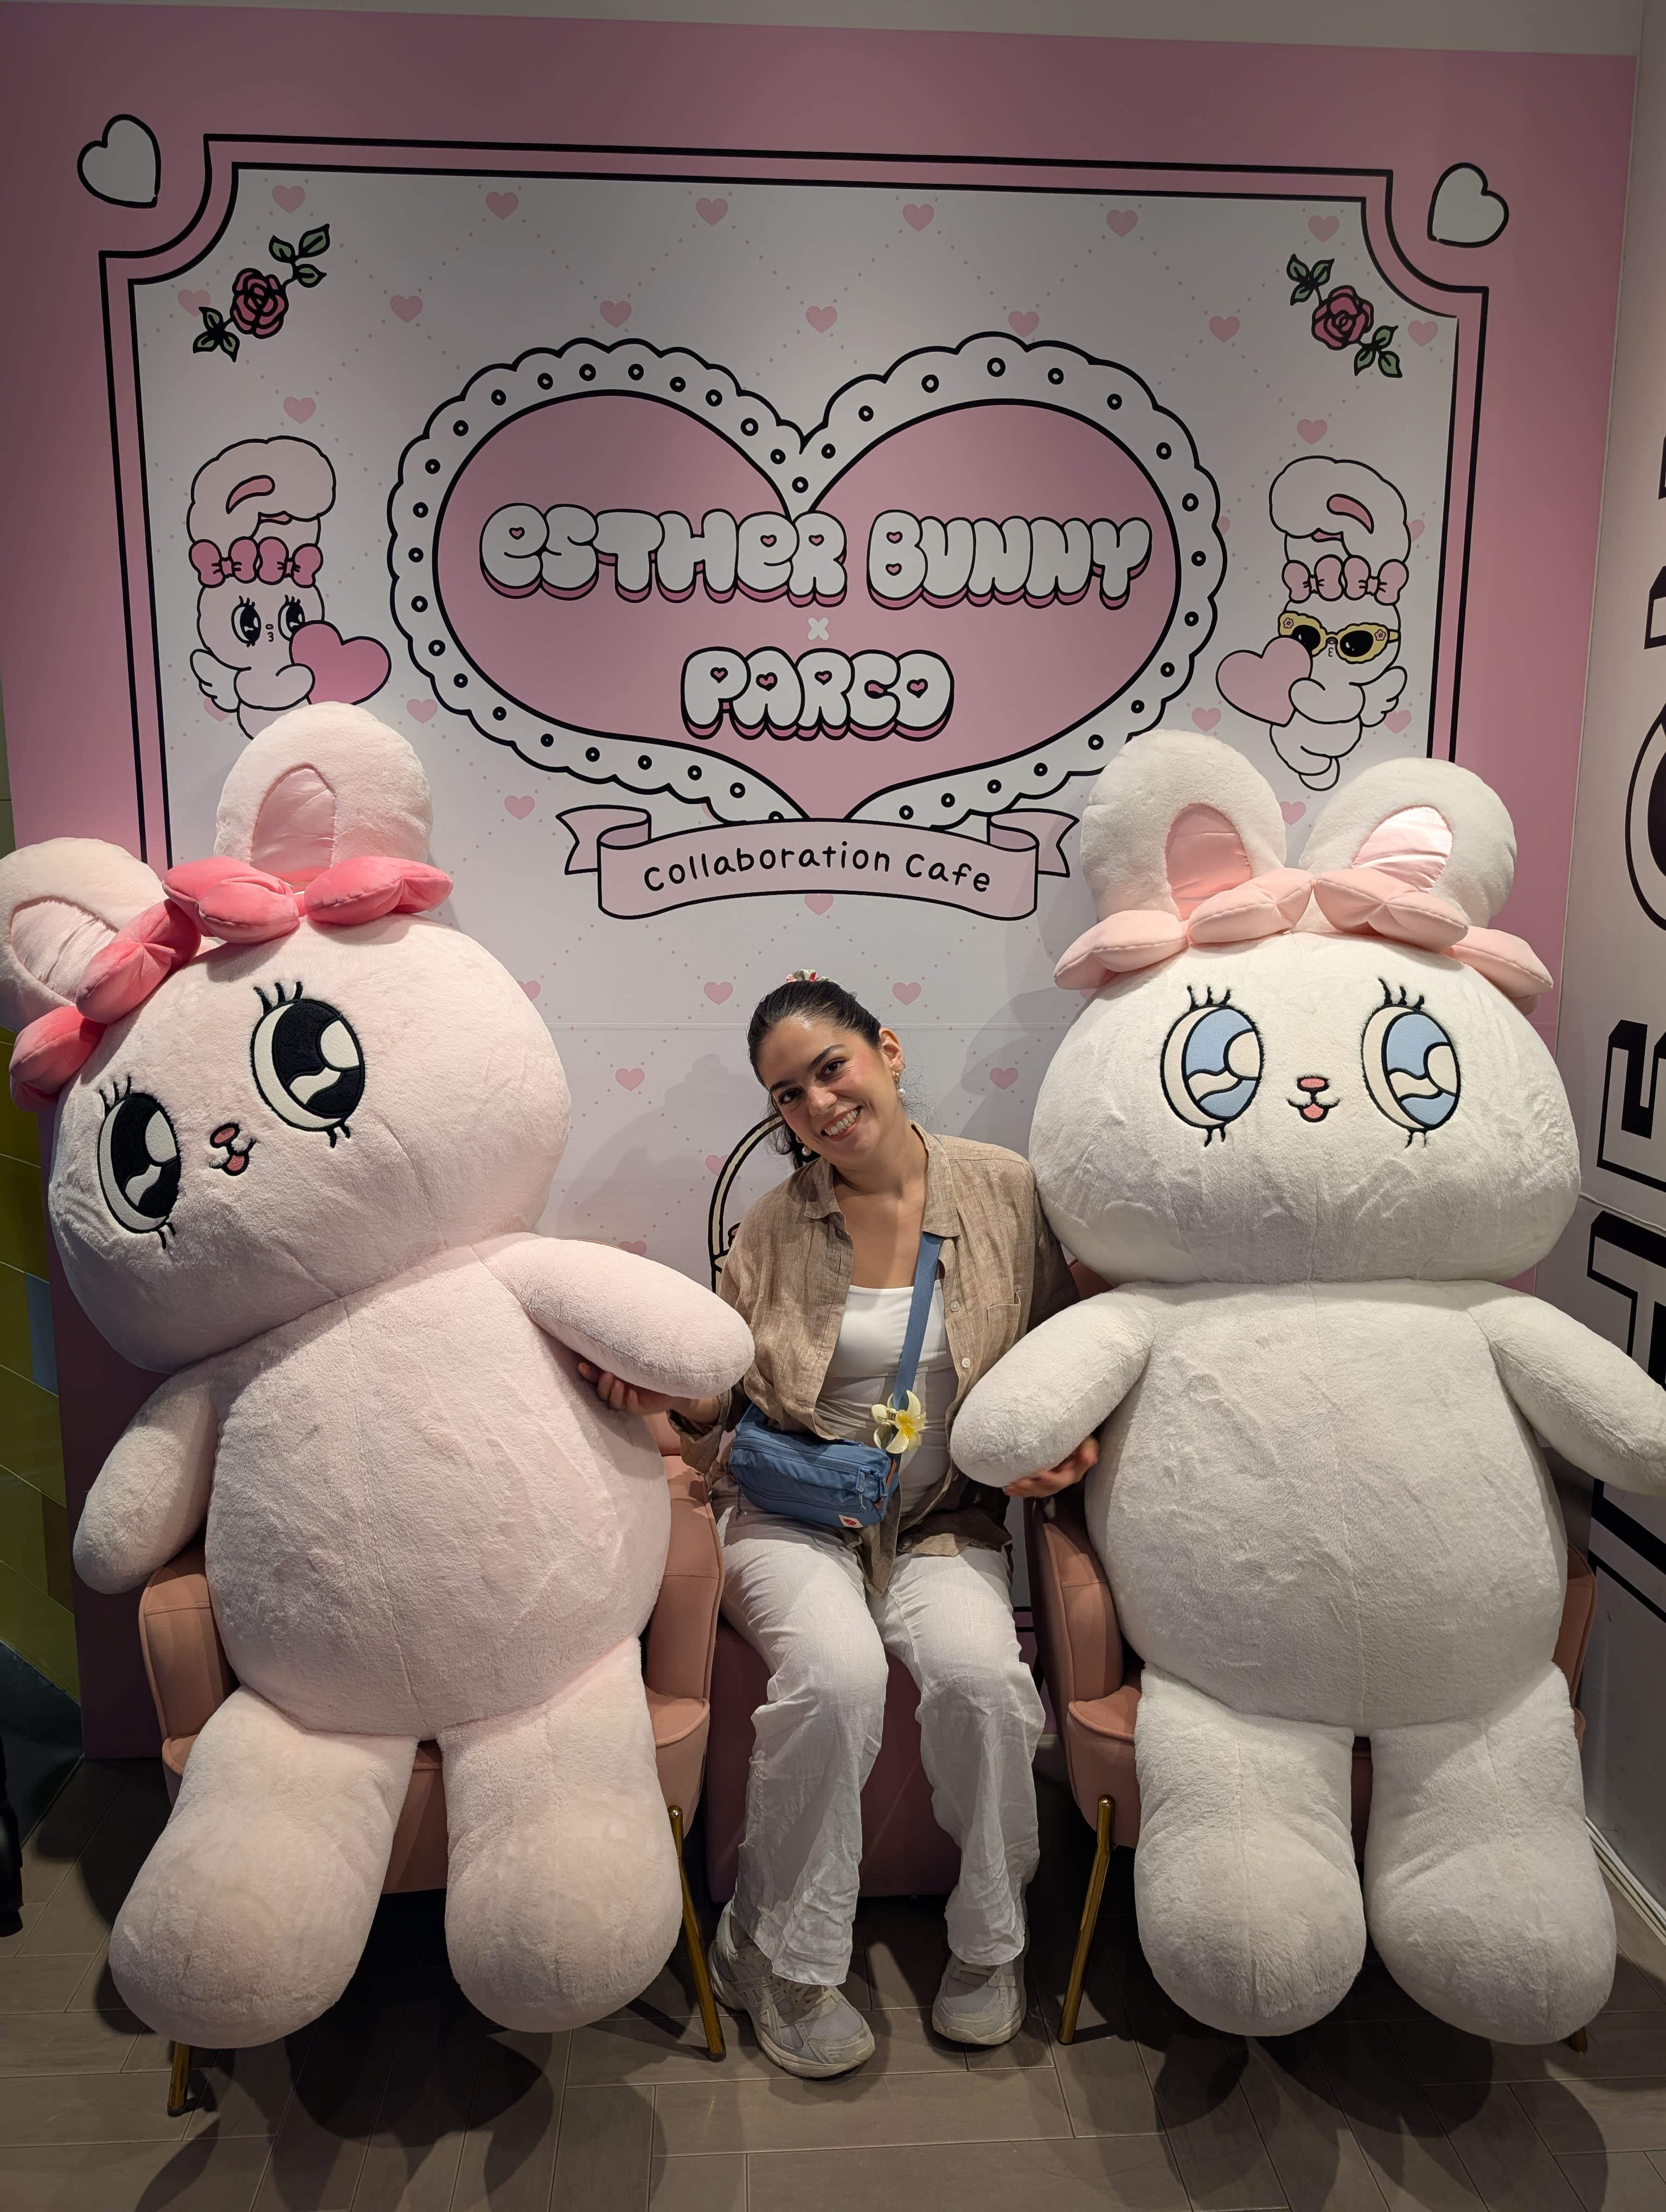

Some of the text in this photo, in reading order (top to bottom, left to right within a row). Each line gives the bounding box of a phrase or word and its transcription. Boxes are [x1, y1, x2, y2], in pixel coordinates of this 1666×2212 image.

[867, 509, 1152, 610] BUNNY
[681, 646, 954, 742] PARCO
[644, 840, 991, 892] Collaboration Cafe
